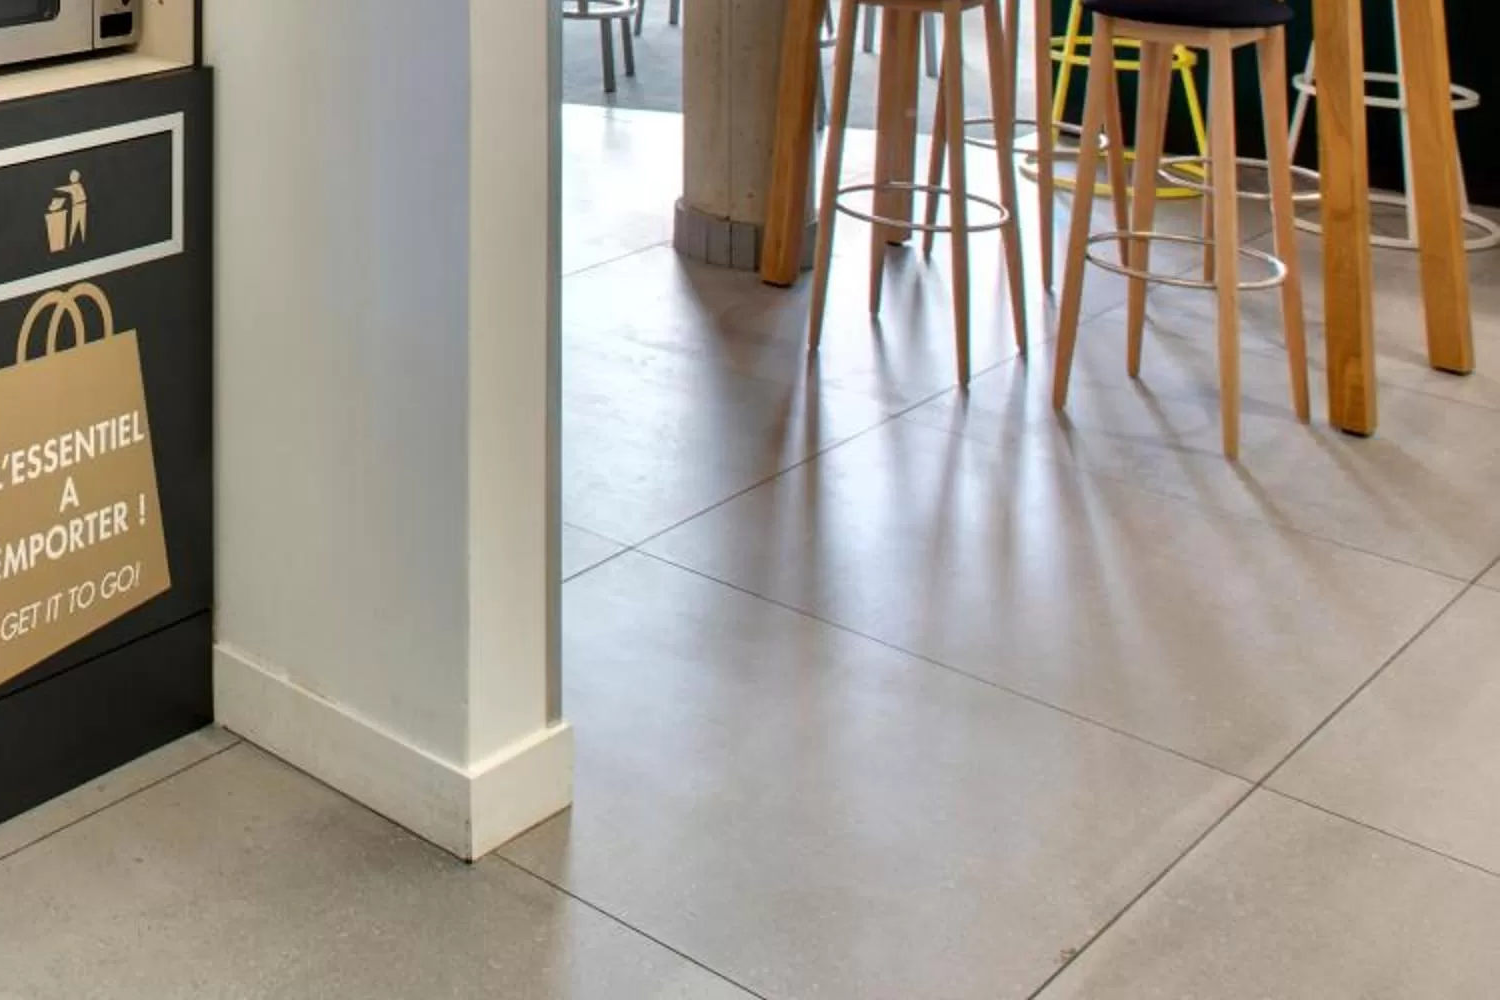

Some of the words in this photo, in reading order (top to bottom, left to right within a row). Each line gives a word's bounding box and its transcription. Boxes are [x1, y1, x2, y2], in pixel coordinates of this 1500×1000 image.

[59, 476, 80, 513] A
[0, 601, 41, 642] GET
[45, 591, 63, 625] IT
[68, 580, 95, 614] TO
[100, 561, 142, 600] GO!
